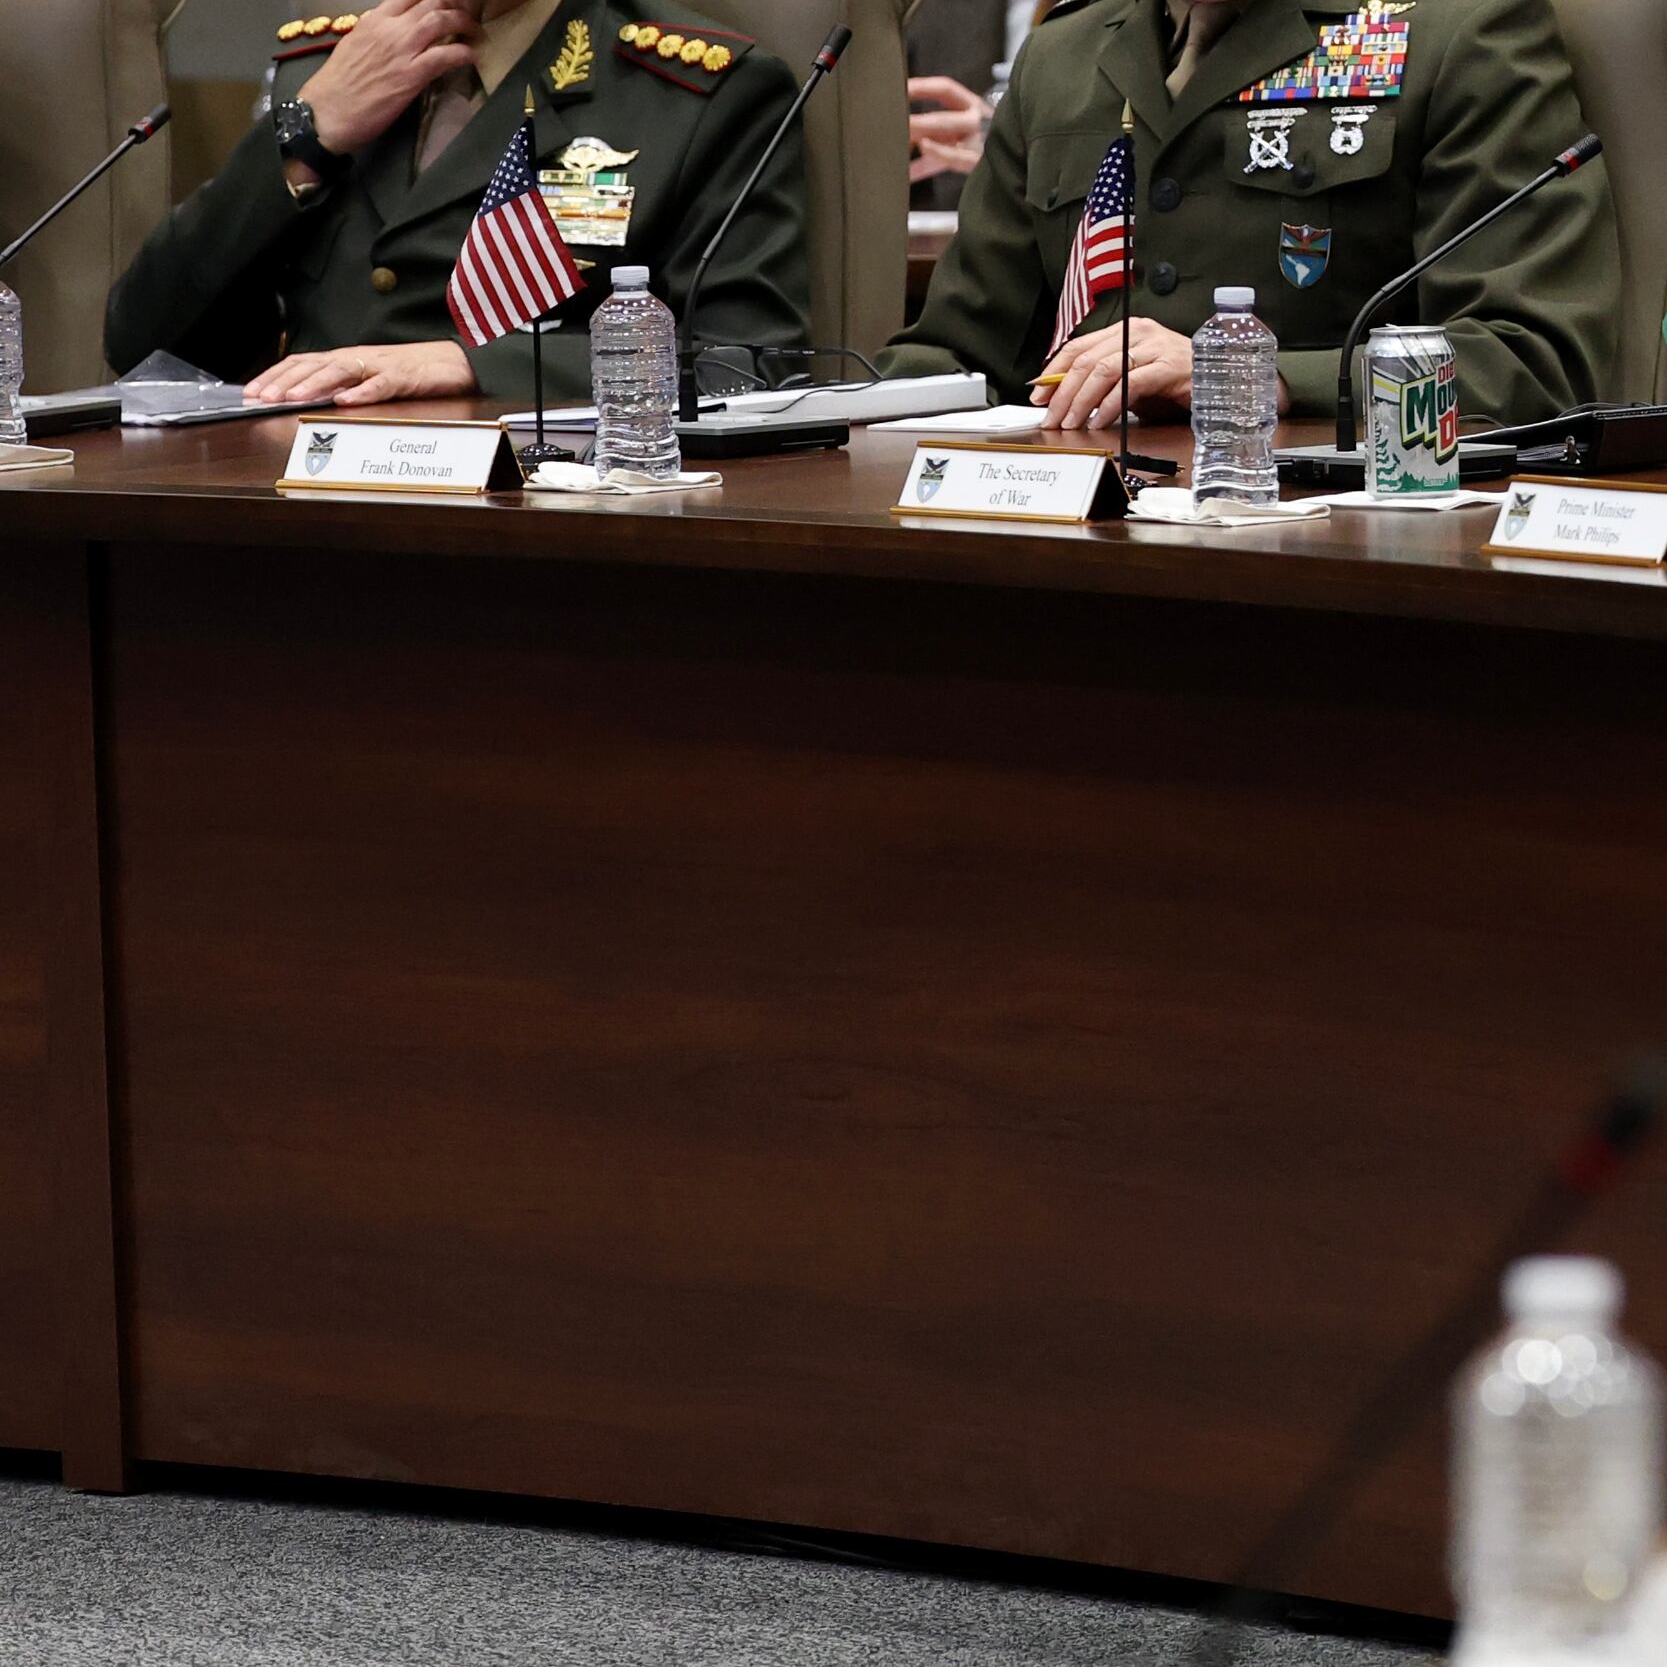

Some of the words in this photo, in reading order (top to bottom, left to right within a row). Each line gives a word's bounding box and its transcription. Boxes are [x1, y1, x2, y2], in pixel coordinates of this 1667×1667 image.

[389, 438, 438, 455] General
[360, 460, 394, 476] Frank
[398, 461, 453, 478] Donovan
[978, 463, 1001, 480] The
[1003, 465, 1061, 487] Secretary
[989, 489, 1007, 505] of
[1007, 489, 1031, 507] War
[1556, 498, 1589, 516] Prime
[1591, 501, 1636, 520] Minister
[1553, 524, 1581, 541] Mark
